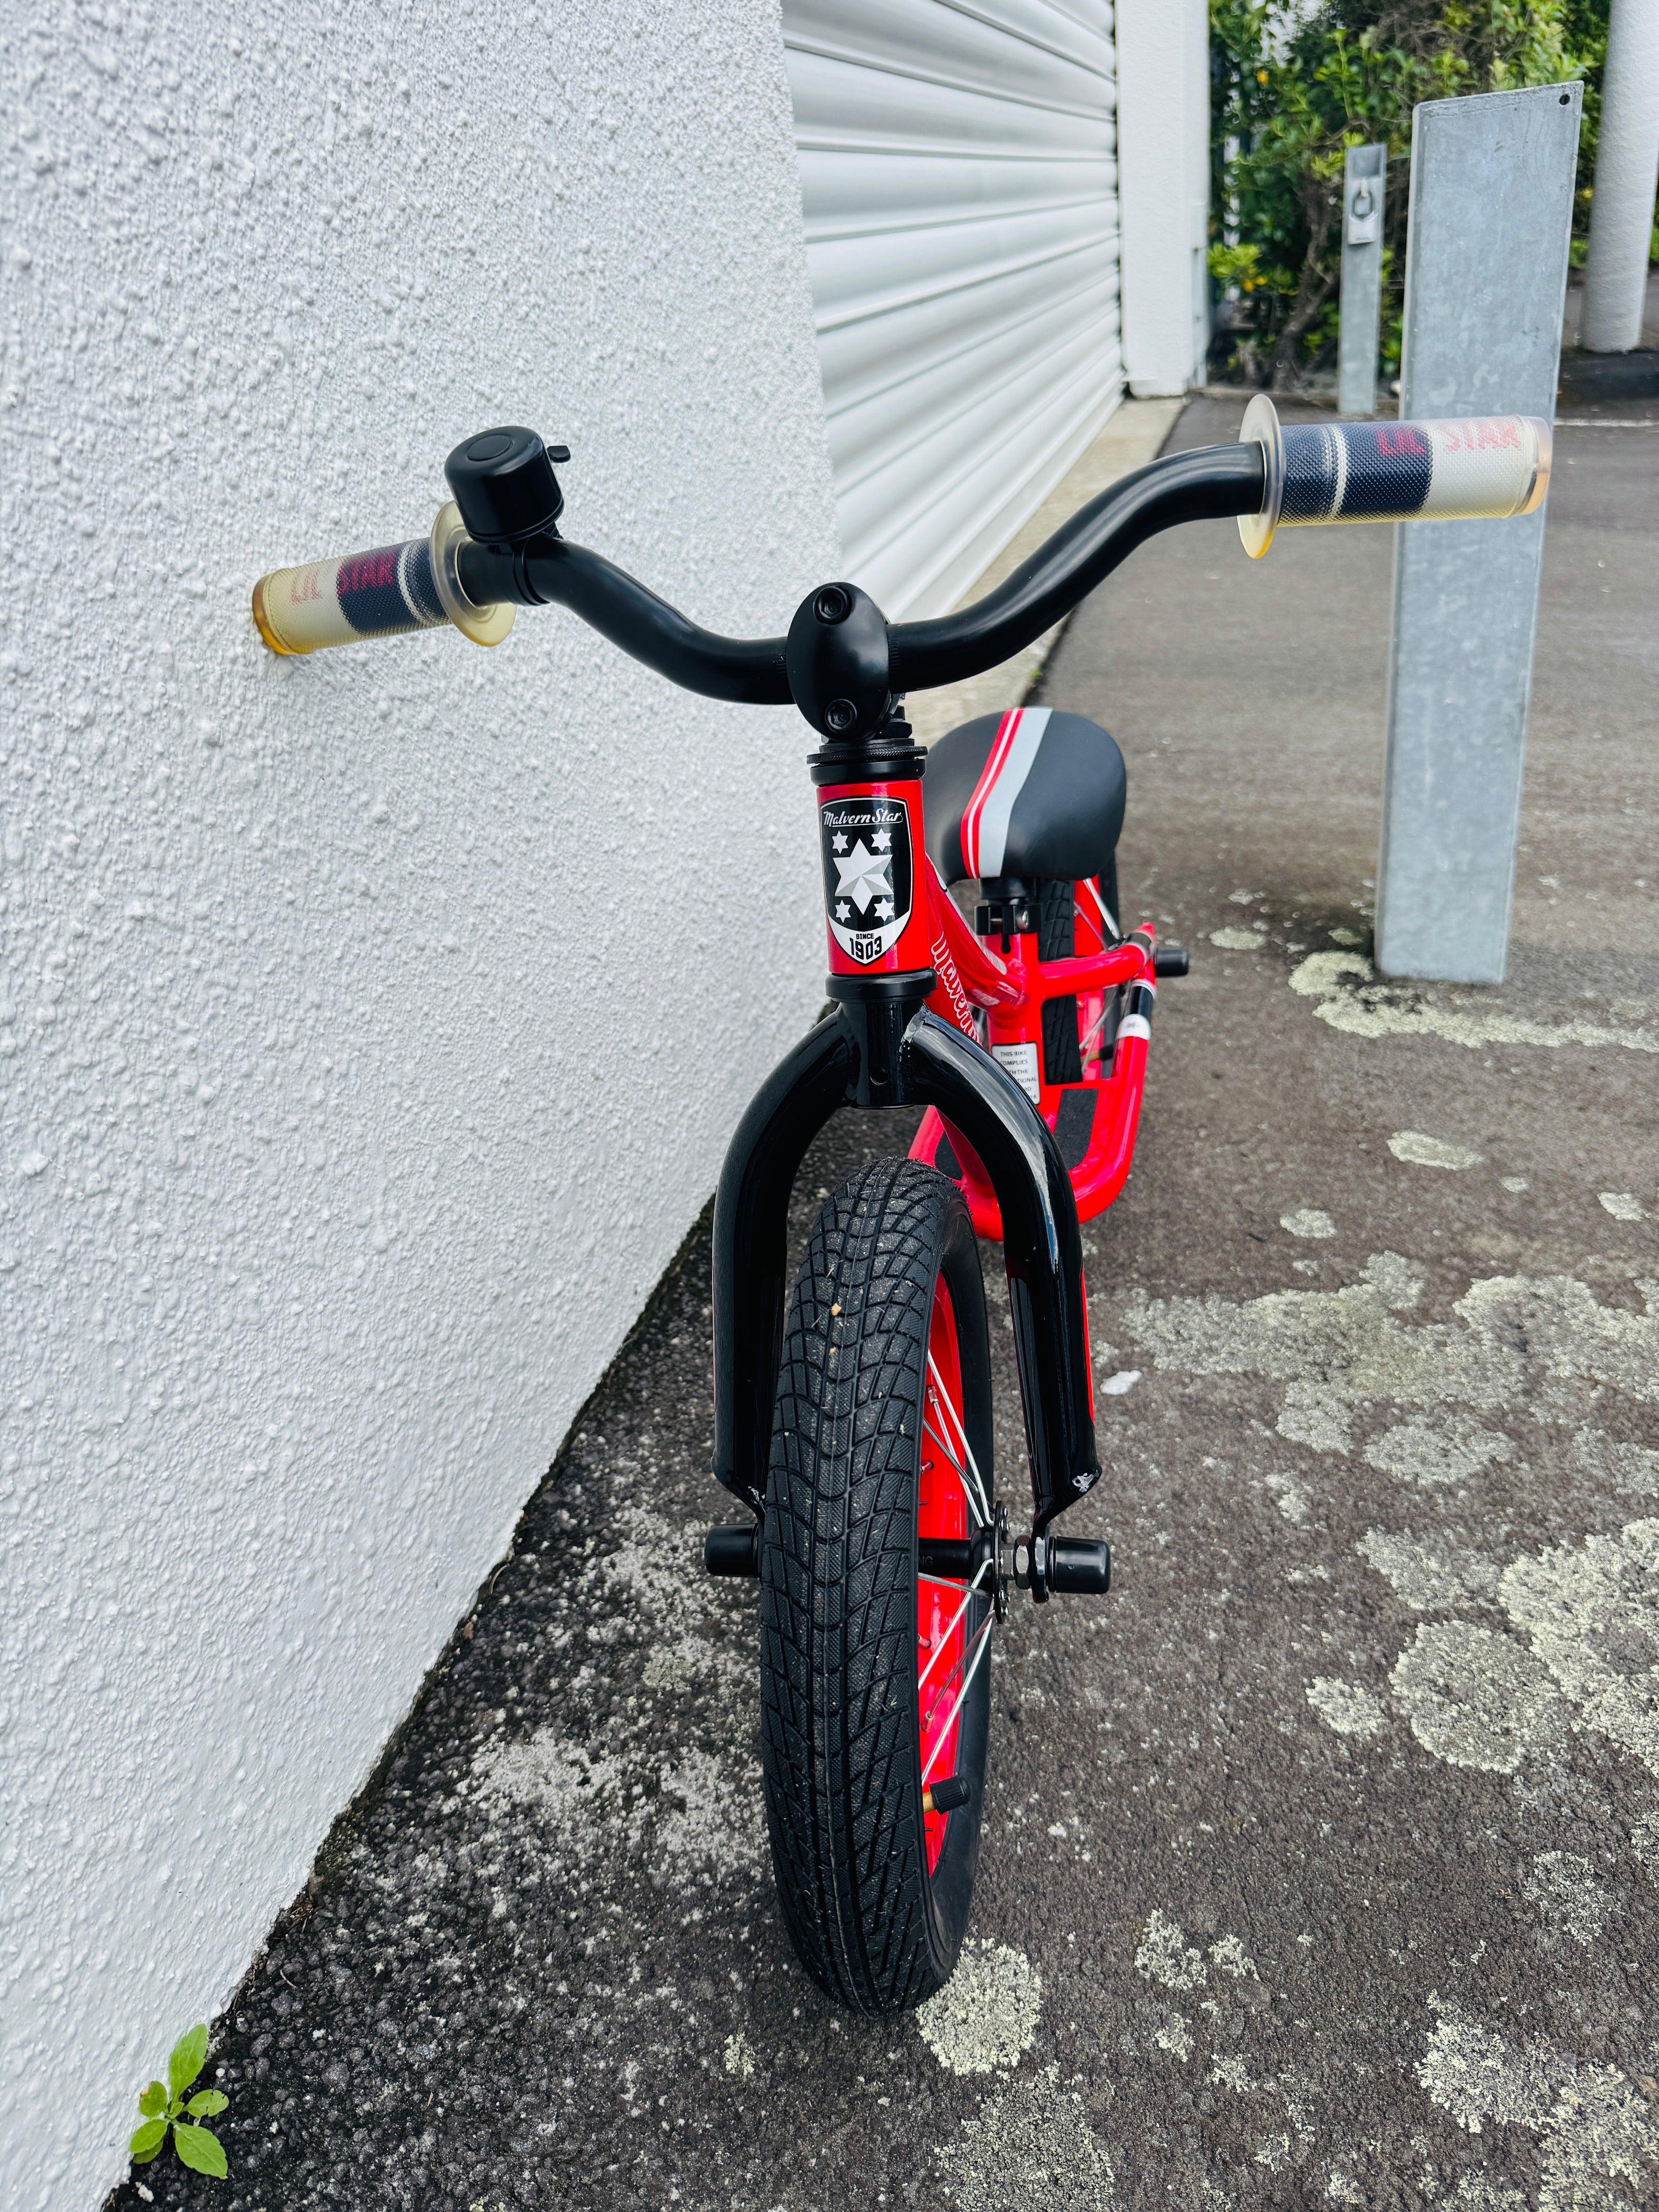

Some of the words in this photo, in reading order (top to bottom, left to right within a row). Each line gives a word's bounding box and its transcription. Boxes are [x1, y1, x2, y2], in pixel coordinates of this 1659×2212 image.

[1377, 427, 1424, 455] LIL
[1437, 421, 1521, 452] STAR
[823, 811, 871, 827] Malvern
[871, 808, 903, 823] Star
[849, 935, 882, 960] 1903
